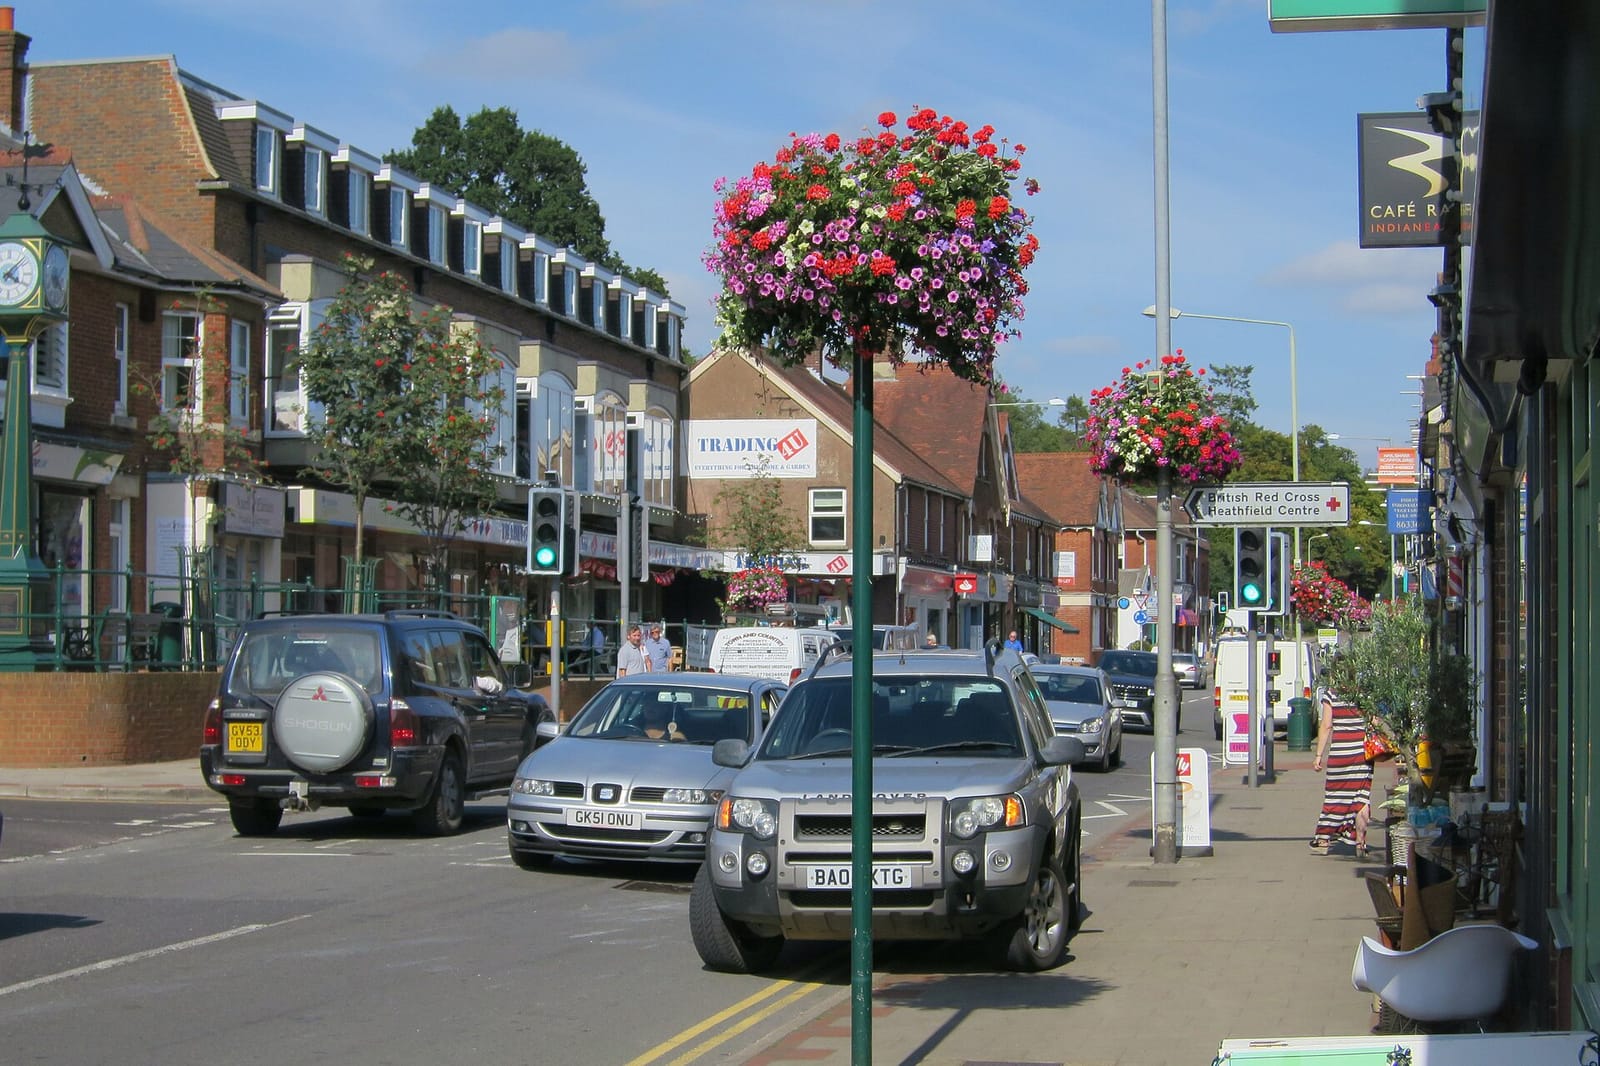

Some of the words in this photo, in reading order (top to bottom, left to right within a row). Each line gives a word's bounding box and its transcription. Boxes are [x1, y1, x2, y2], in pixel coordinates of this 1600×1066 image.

[1370, 201, 1416, 218] CAFÉ
[698, 437, 778, 452] TRADING
[781, 431, 805, 460] 4U
[1208, 492, 1248, 503] British
[1255, 492, 1279, 502] Red
[1284, 492, 1320, 502] Cross
[1208, 505, 1272, 516] Heathfield
[1278, 505, 1320, 516] Centre
[231, 725, 260, 736] GV53
[284, 718, 352, 731] SHOGUN
[235, 737, 256, 748] ODY
[876, 792, 927, 800] OVER
[575, 810, 604, 824] GK51
[608, 812, 634, 827] ONU
[815, 869, 850, 885] BA0
